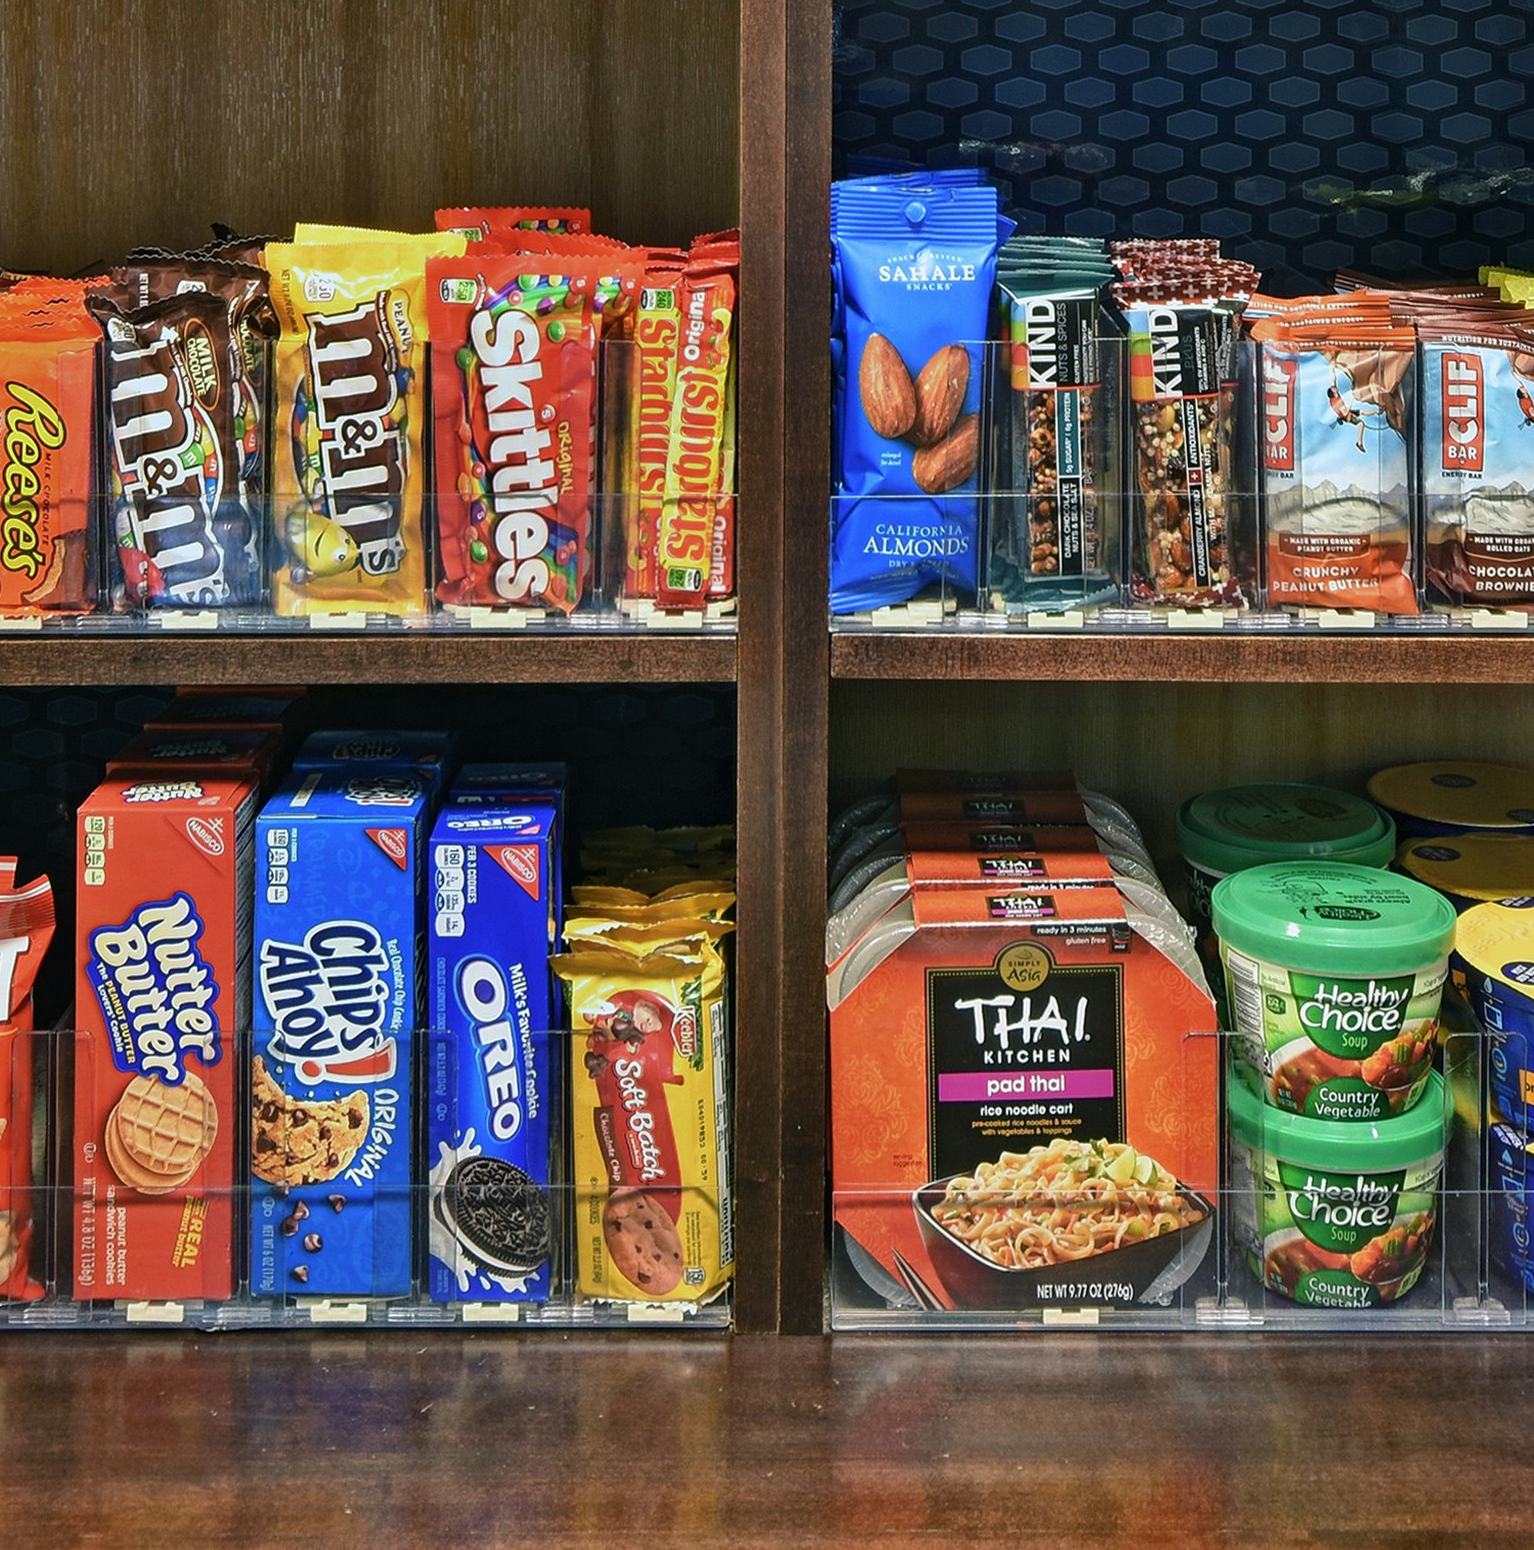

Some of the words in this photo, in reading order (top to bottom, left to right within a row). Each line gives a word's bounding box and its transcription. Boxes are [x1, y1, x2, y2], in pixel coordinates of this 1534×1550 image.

[879, 265, 975, 282] SAHALE
[907, 283, 949, 291] SNACKS
[1026, 300, 1055, 388] KIND
[1152, 310, 1181, 397] KIND
[1448, 355, 1478, 443] CLIF
[471, 310, 559, 601] Skittles
[1448, 446, 1478, 461] BAR
[667, 371, 720, 561] Starburst
[0, 383, 67, 578] Reese's
[876, 523, 962, 536] CALIFORNIA
[863, 536, 969, 557] ALMONDS
[1293, 566, 1359, 578] CRUNCHY
[1273, 581, 1325, 592] PEANUT
[1329, 578, 1379, 591] BUTTER
[139, 897, 220, 1064] Nutter
[308, 924, 376, 1050] Chips
[1317, 982, 1409, 1009] Healthy
[92, 929, 181, 1086] Butter
[1300, 1003, 1402, 1030] Choice
[955, 995, 1091, 1047] THAI
[458, 960, 521, 1142] OREO
[1342, 1033, 1368, 1049] Soup
[984, 1048, 1070, 1064] KITCHEN
[987, 1078, 1025, 1095] pad
[1030, 1075, 1065, 1093] thai
[1319, 1087, 1379, 1105] Country
[979, 1104, 1006, 1116] rice
[1008, 1104, 1046, 1116] noodle
[1049, 1104, 1072, 1116] cart
[1315, 1102, 1381, 1119] Vegetable
[1037, 1284, 1055, 1299] NET
[1058, 1284, 1067, 1299] WT
[1068, 1284, 1087, 1299] 9.77
[1089, 1284, 1101, 1299] OZ
[1103, 1284, 1133, 1299] (276g)
